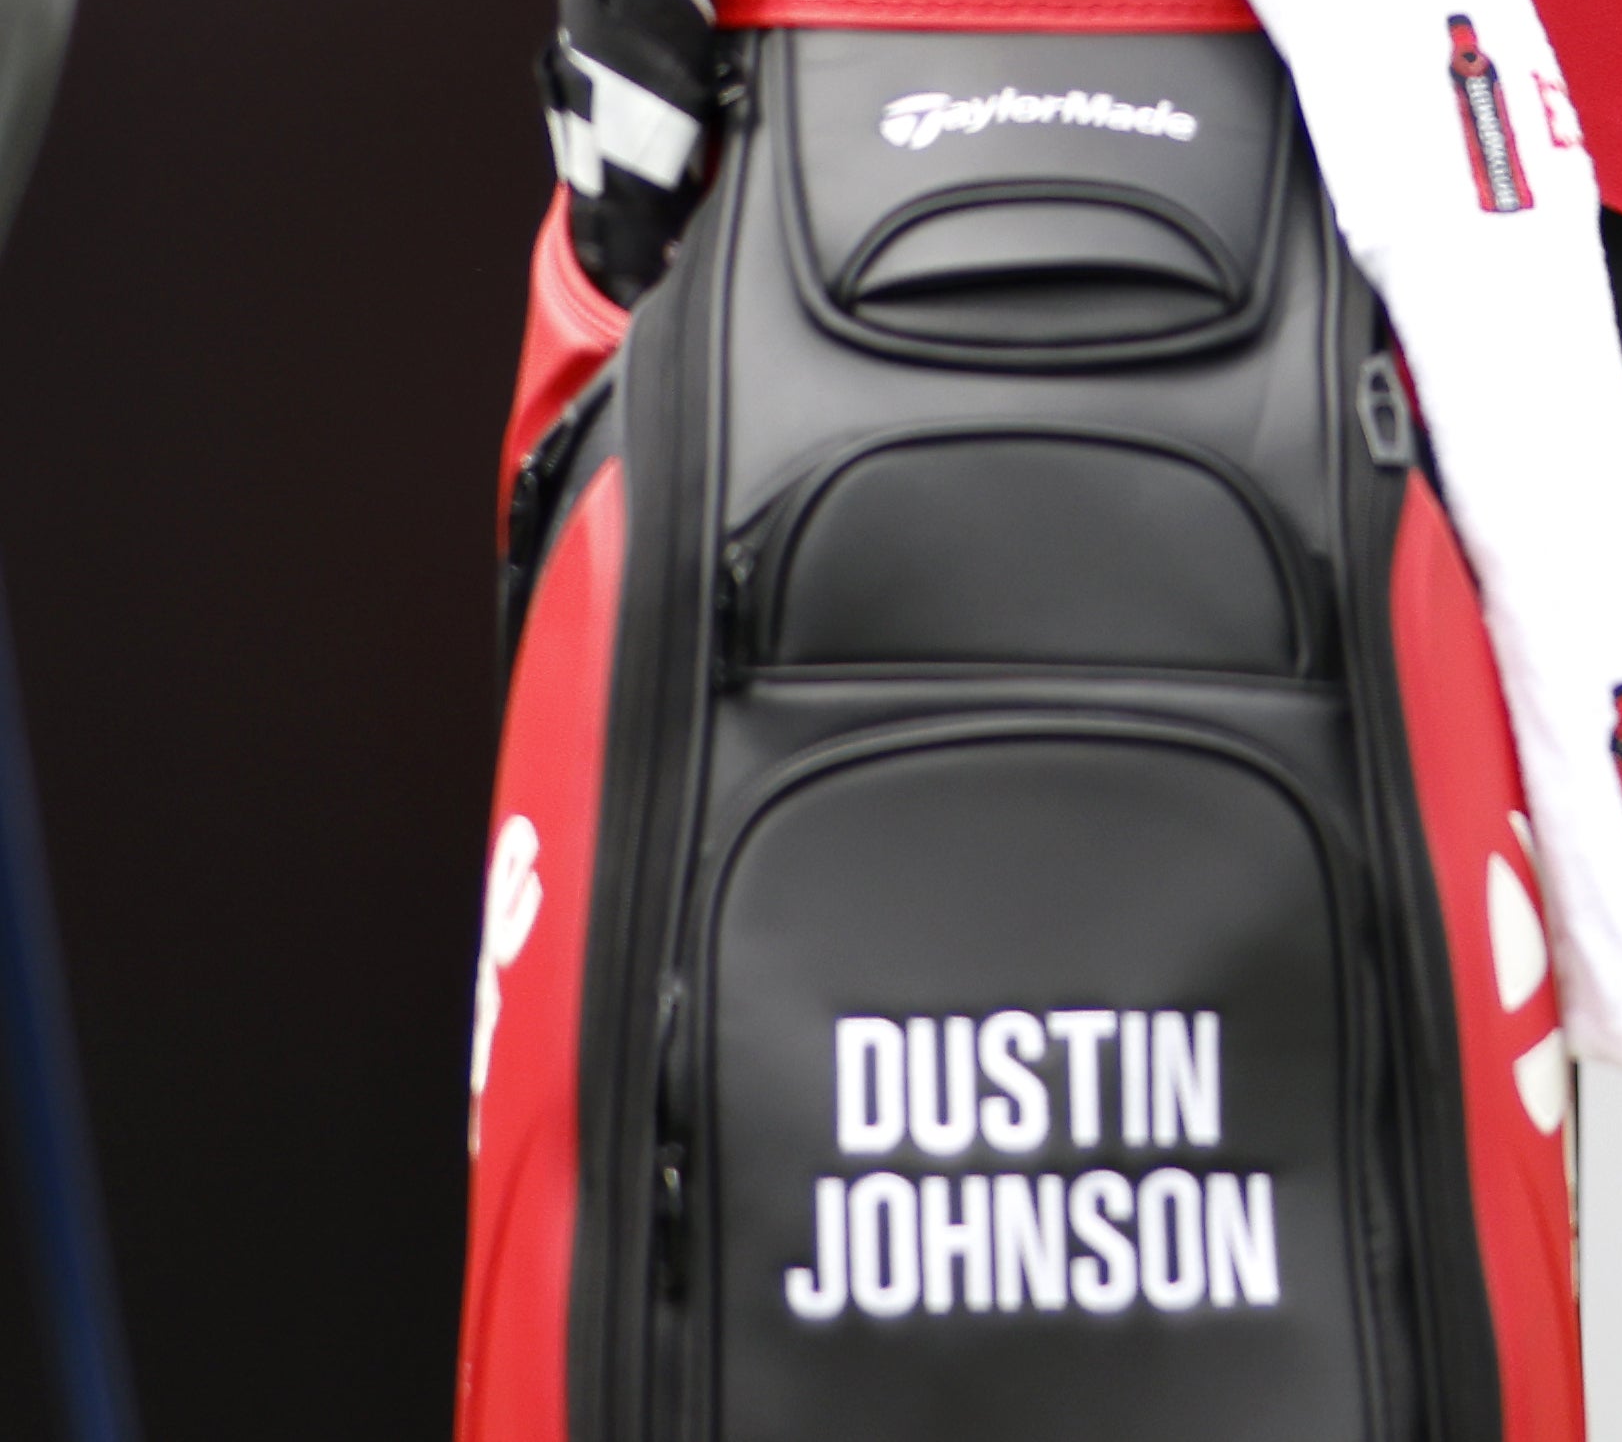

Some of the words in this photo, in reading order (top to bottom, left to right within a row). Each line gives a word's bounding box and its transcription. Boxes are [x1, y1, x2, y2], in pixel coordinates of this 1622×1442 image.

[880, 85, 1198, 151] TaylorMade
[834, 1008, 1223, 1158] DUSTIN
[783, 1166, 1281, 1319] JOHNSON
